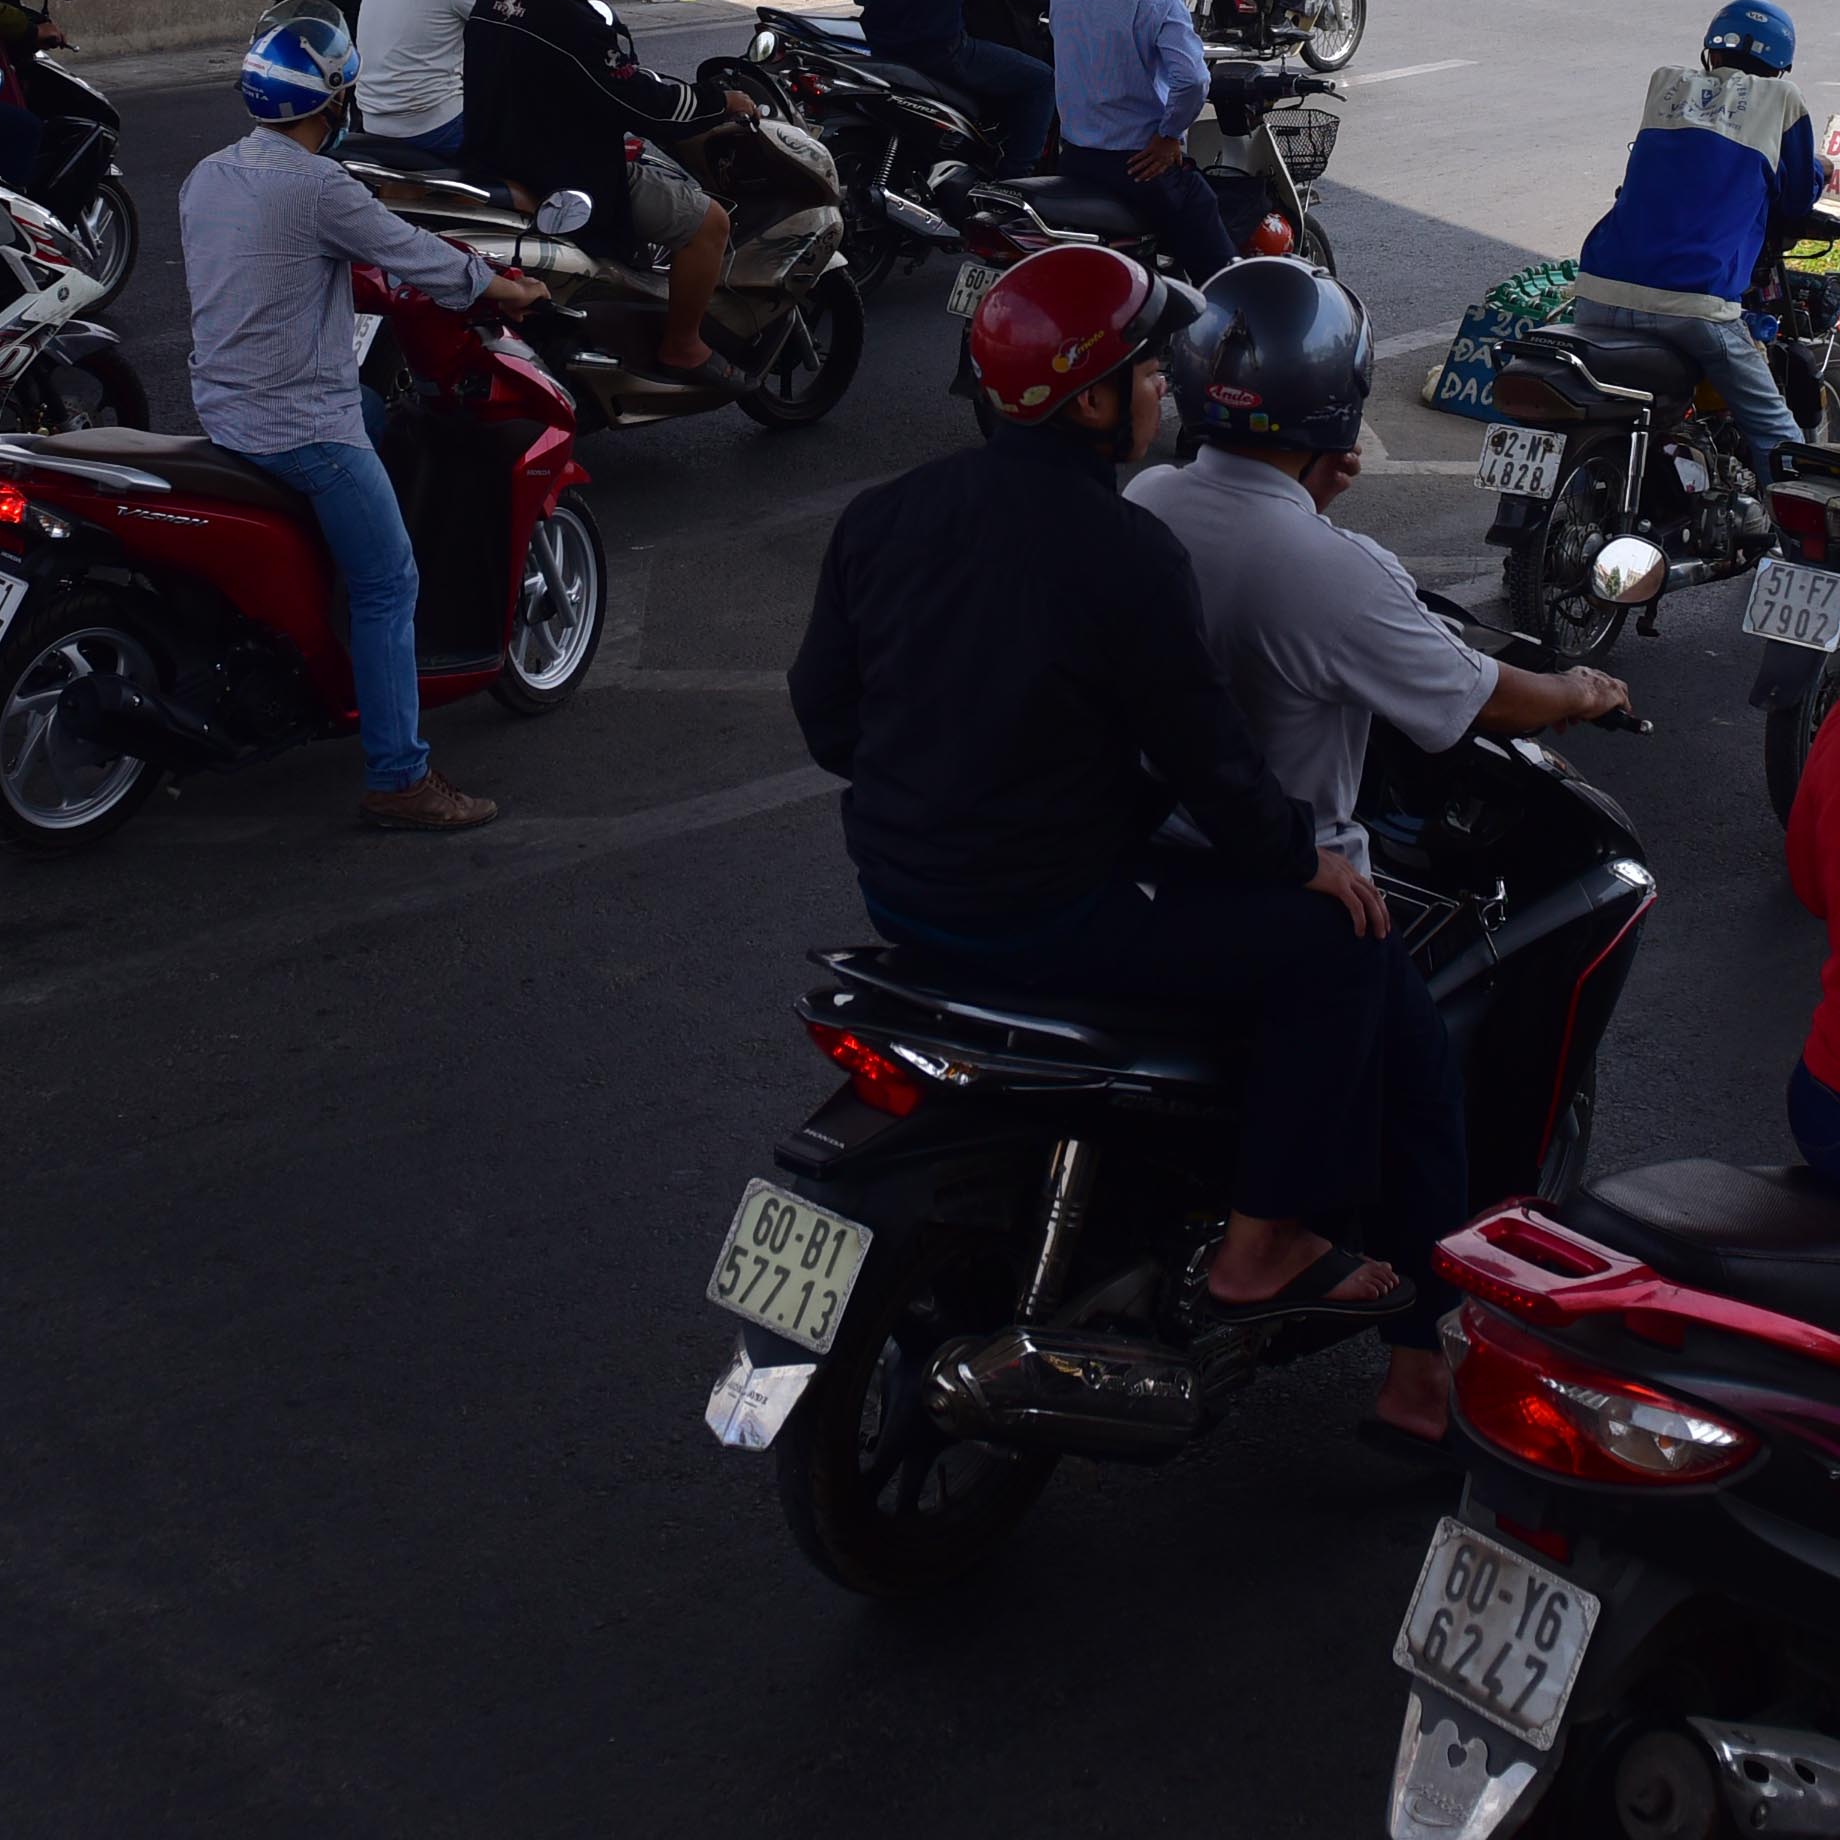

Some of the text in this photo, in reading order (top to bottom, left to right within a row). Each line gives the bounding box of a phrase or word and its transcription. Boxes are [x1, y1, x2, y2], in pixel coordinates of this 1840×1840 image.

[116, 505, 210, 527] VISION
[1757, 598, 1829, 645] 7902
[1764, 566, 1837, 608] 51-F7
[752, 1198, 847, 1280] 60-B1
[718, 1245, 838, 1342] 577.13
[1445, 1544, 1569, 1653] 60-Y6
[1422, 1608, 1548, 1715] 6247
